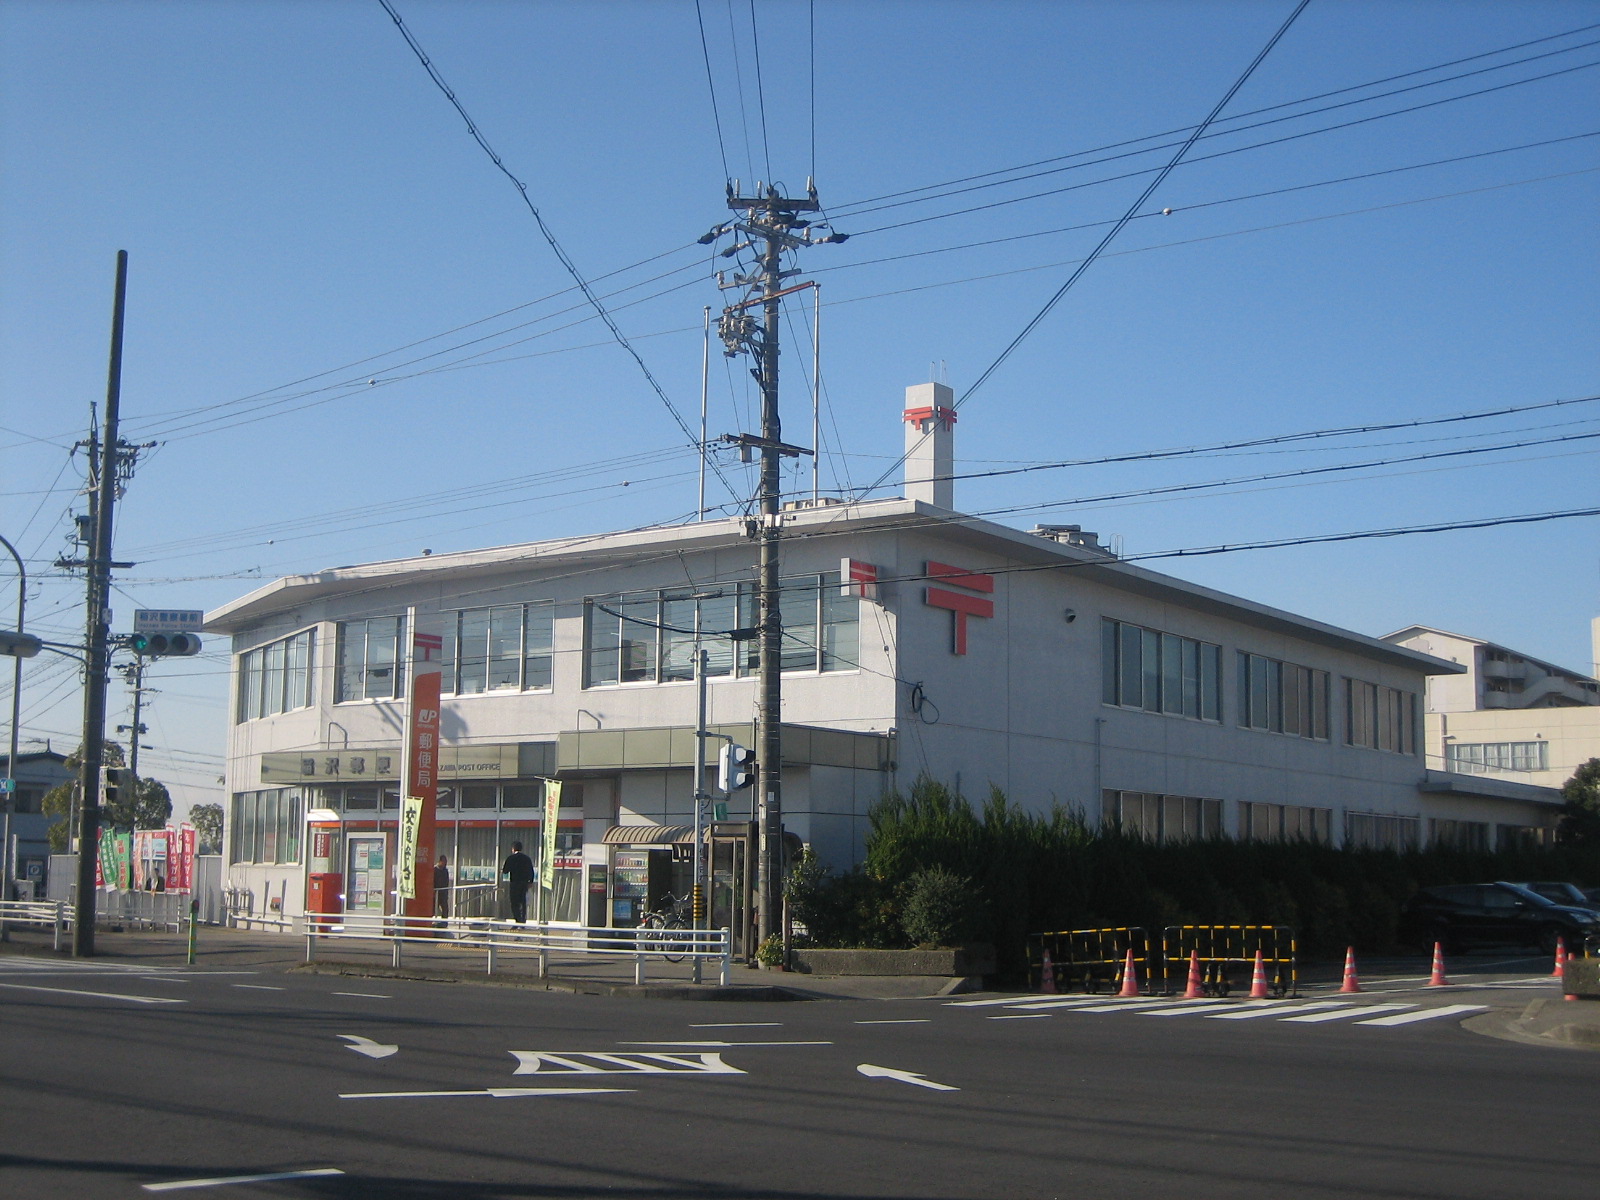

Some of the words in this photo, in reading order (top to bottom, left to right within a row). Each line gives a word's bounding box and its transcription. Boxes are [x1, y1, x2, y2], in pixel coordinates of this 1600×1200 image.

[417, 732, 432, 788] 郵便局
[476, 763, 501, 771] OFFICE
